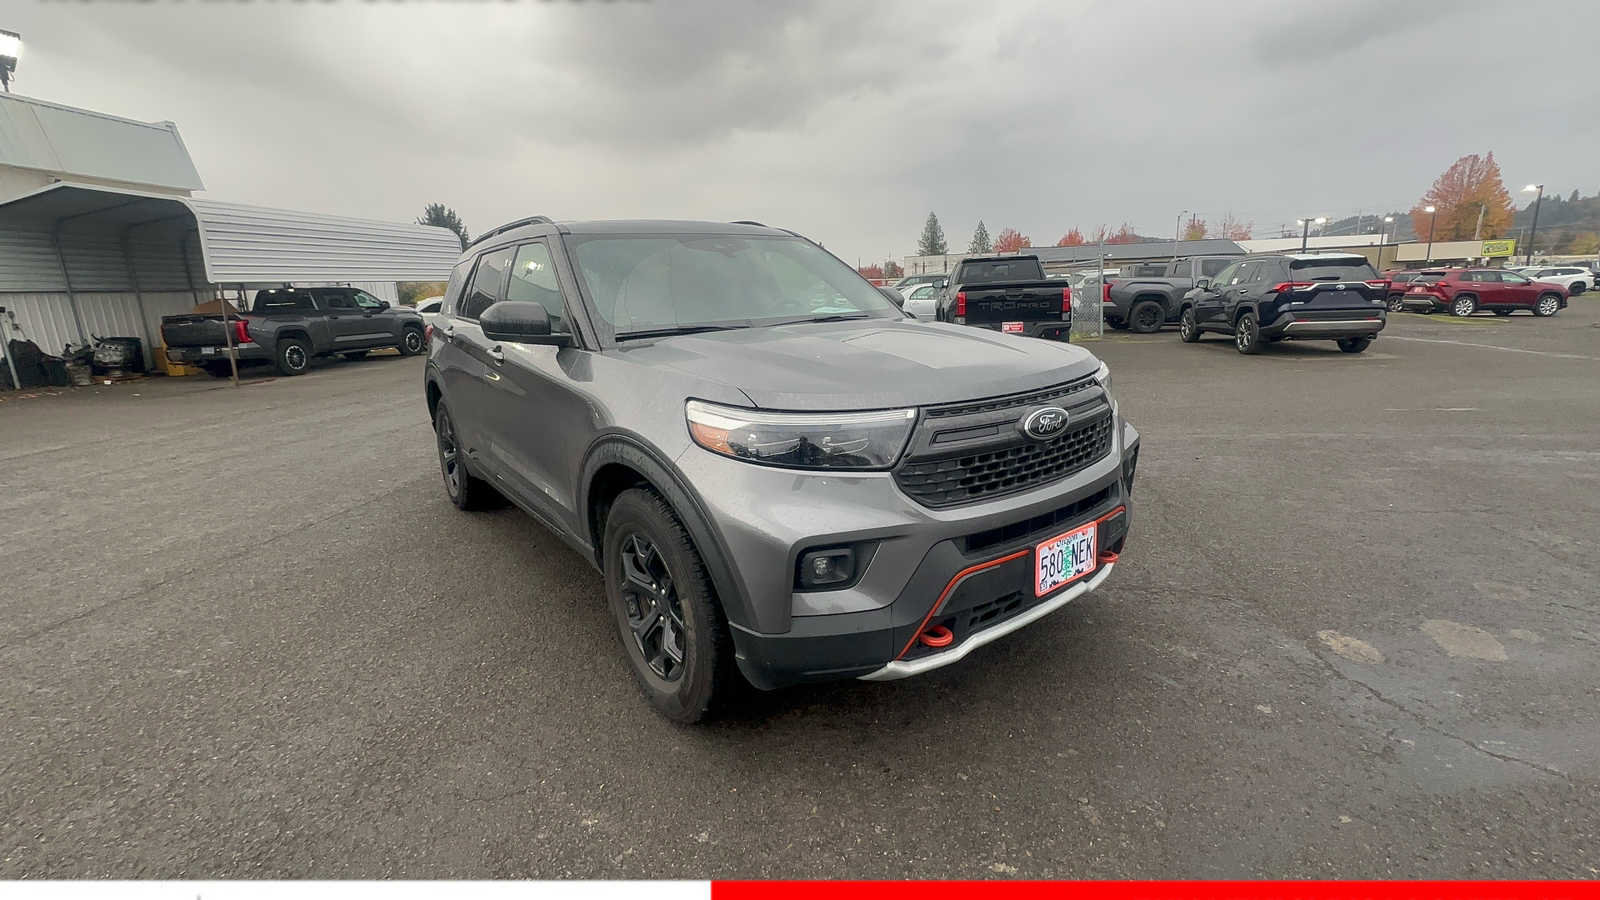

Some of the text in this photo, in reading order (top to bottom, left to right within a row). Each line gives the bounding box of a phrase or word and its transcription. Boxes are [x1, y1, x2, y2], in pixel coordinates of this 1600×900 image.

[1039, 413, 1062, 433] Ford
[1041, 536, 1093, 582] 580 NEK
